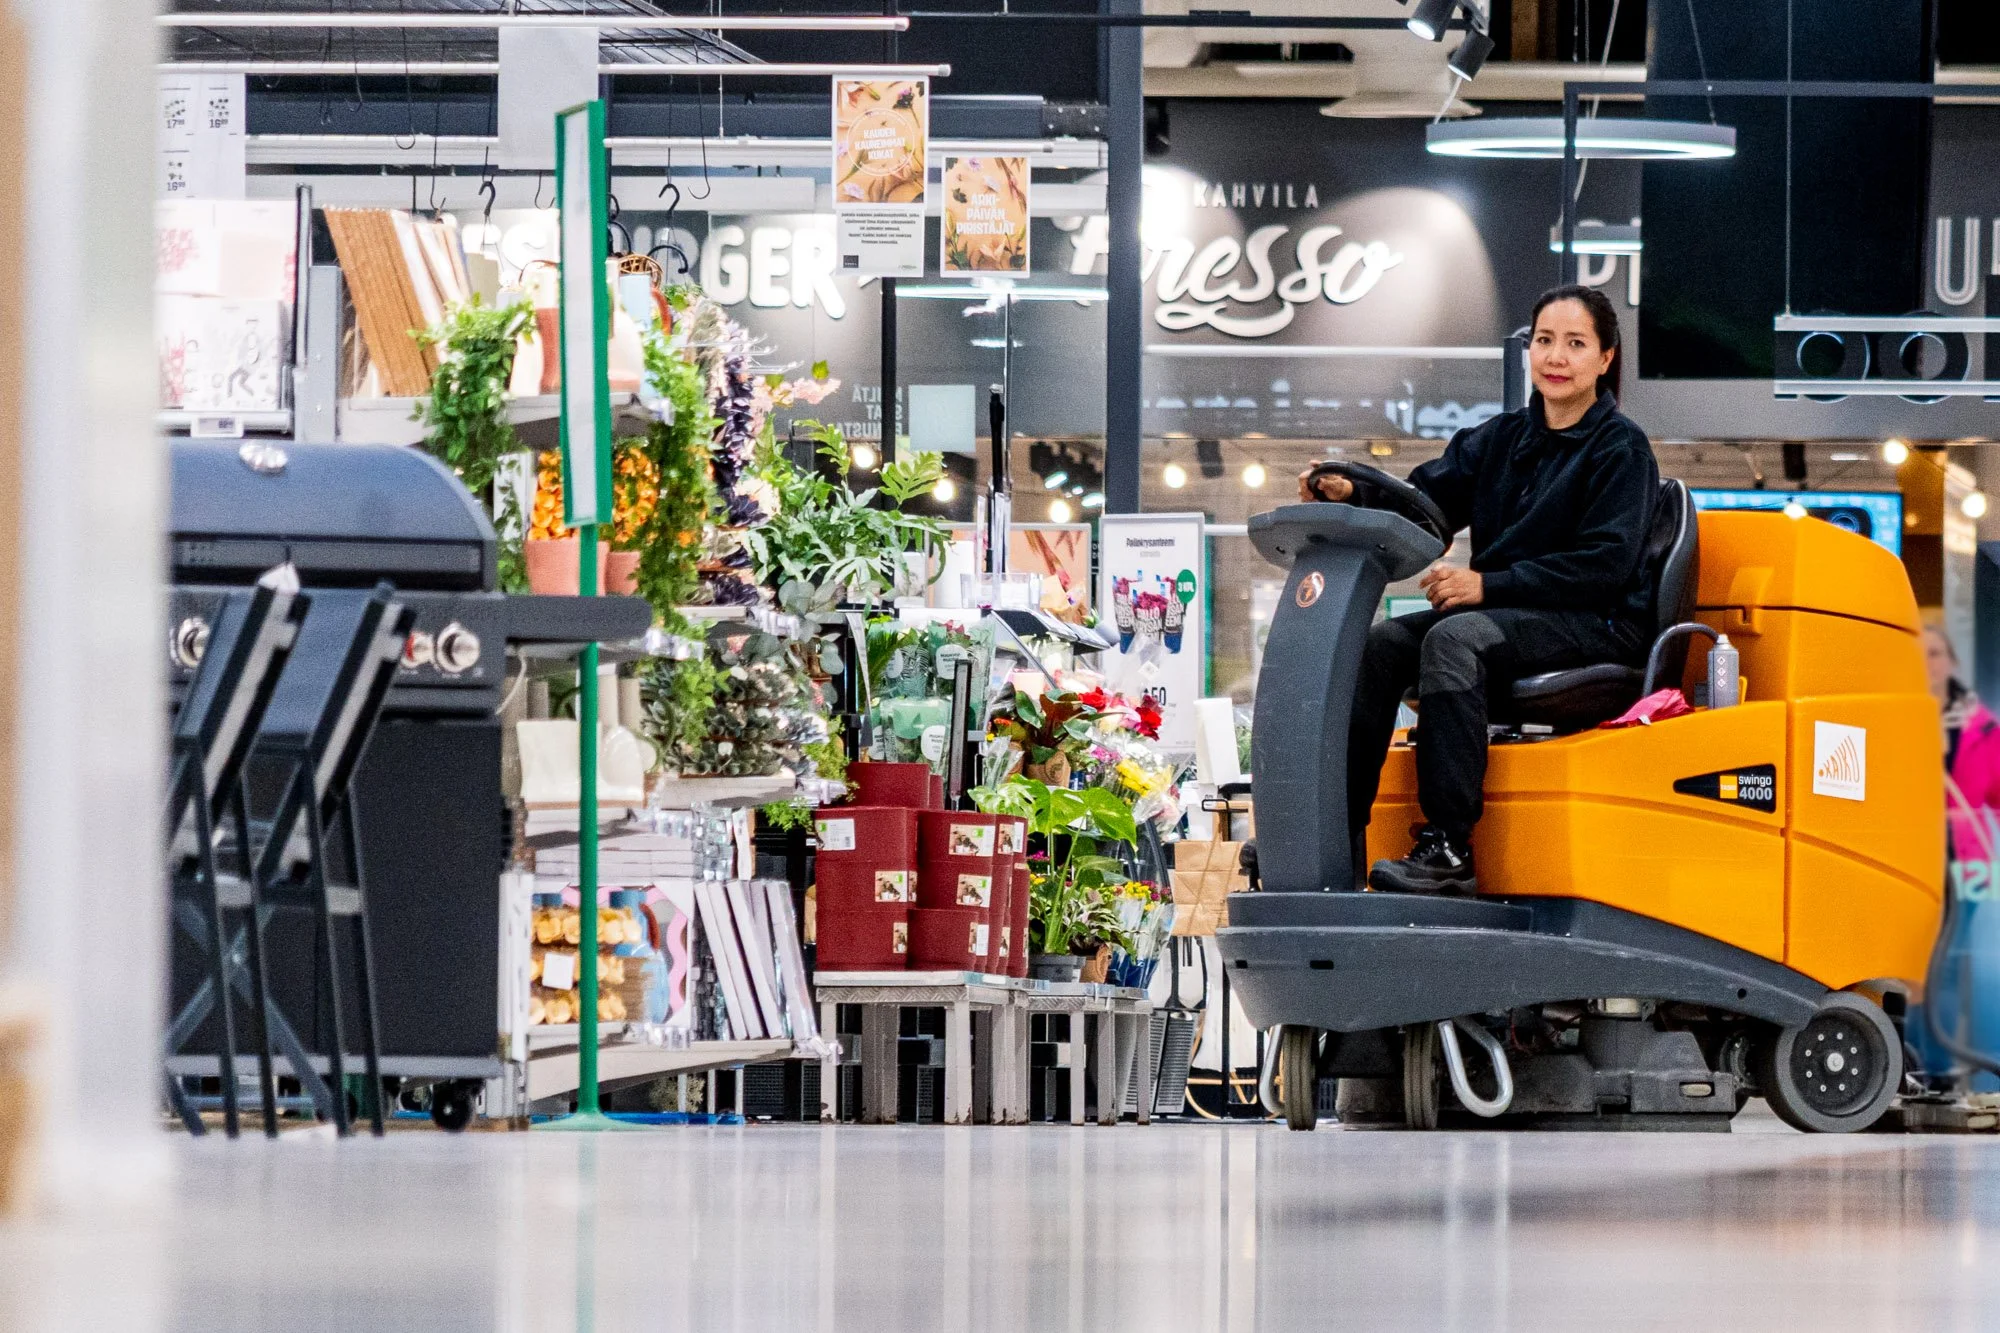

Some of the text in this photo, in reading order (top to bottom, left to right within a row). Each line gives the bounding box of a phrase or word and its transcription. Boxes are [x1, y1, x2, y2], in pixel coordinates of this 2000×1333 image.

[868, 149, 894, 160] KUKAT
[971, 193, 1000, 207] ARKI-
[1194, 183, 1319, 208] KAHVILA
[1738, 774, 1772, 787] swingo
[1739, 787, 1772, 800] 4000
